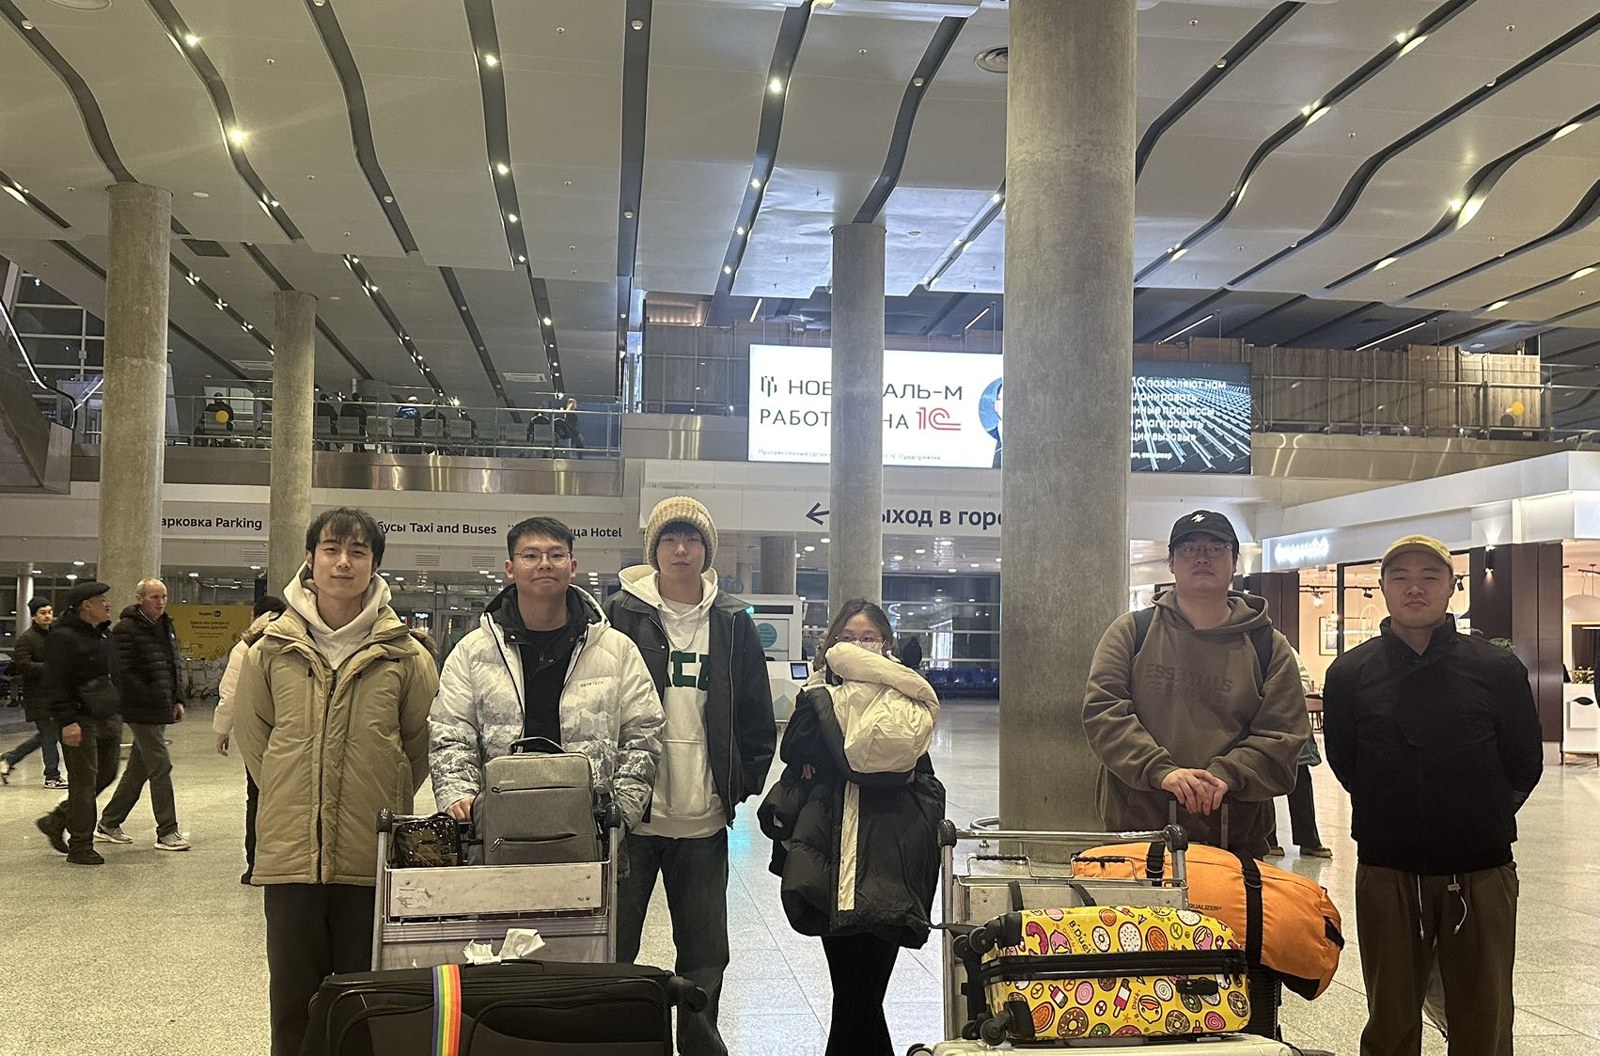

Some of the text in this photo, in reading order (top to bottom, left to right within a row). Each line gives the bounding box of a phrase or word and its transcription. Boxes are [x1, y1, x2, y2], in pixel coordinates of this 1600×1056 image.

[1132, 393, 1198, 403] ланировать
[760, 408, 832, 427] РАБОТ
[162, 516, 262, 531] арковка Parking
[882, 508, 1002, 530] ыход в гор
[377, 521, 497, 534] бусы Taxi and Buses
[590, 527, 622, 538] Hotel
